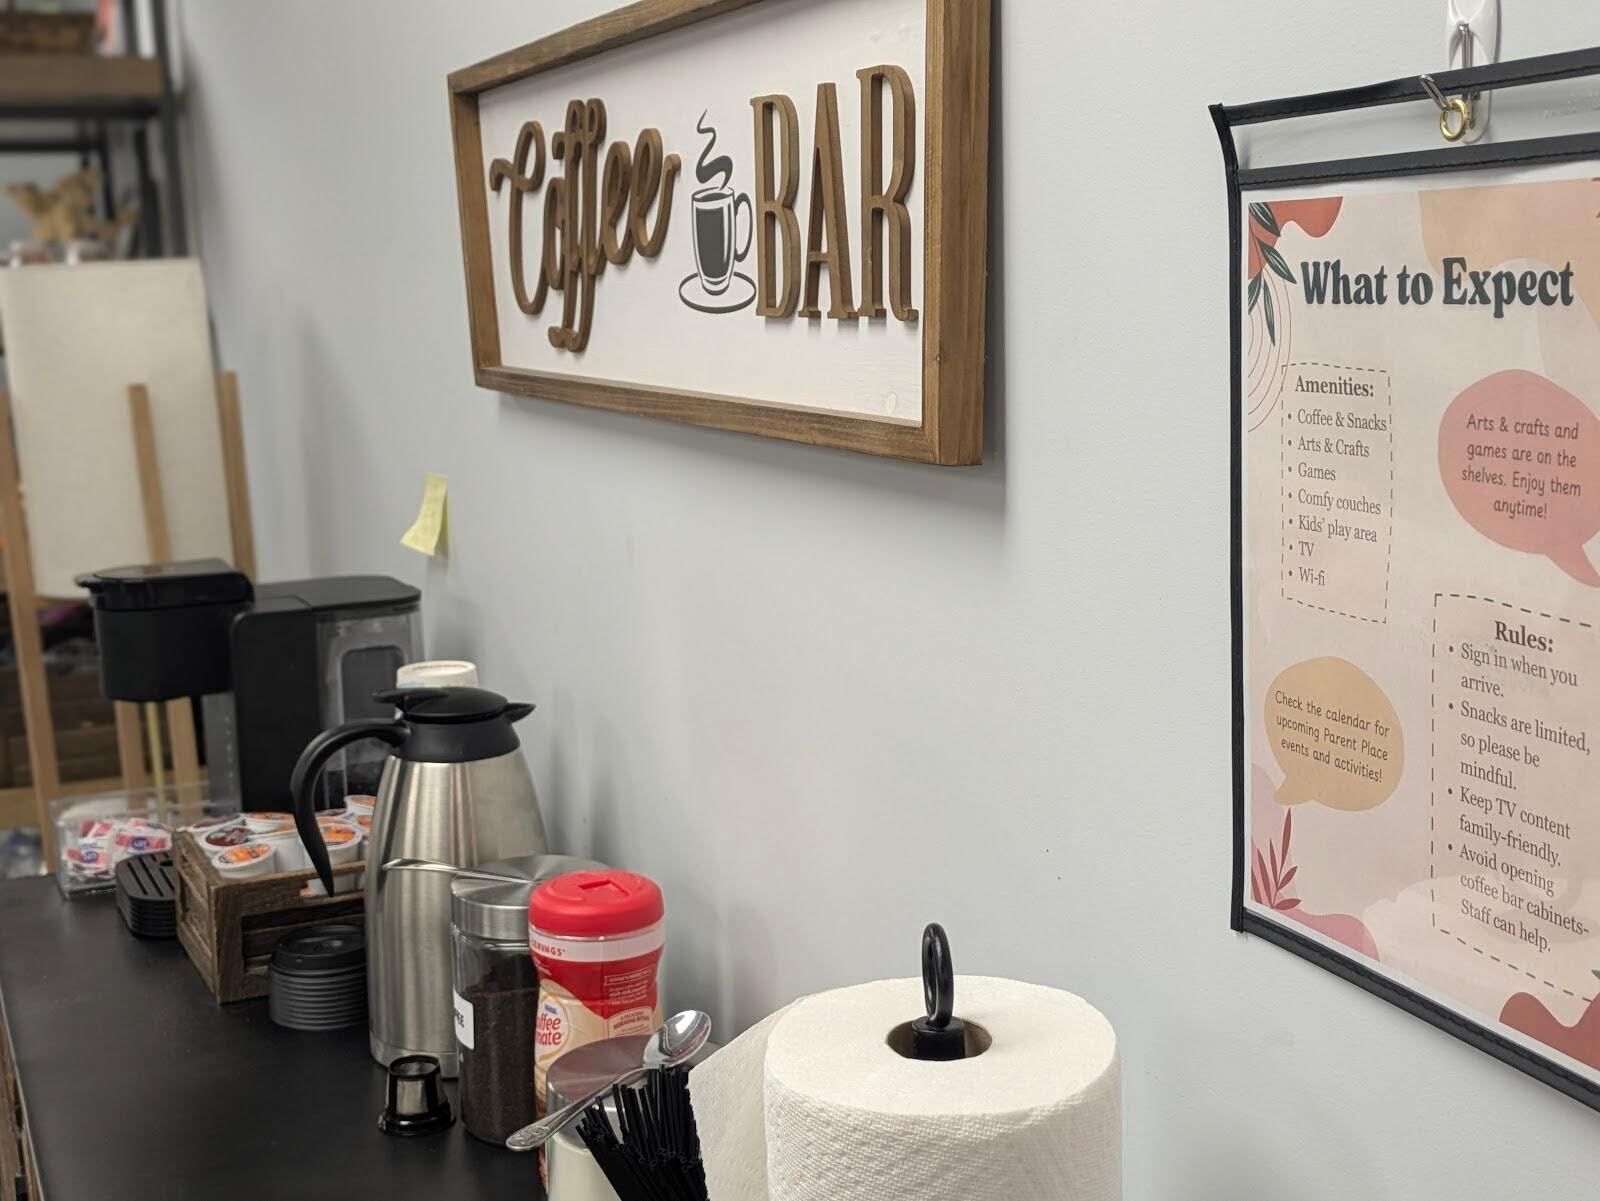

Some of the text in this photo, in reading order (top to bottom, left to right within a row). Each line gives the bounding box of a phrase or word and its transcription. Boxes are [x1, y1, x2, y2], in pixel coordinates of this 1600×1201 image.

[489, 64, 919, 352] Coffee BAR
[1300, 257, 1574, 318] What to Expect
[1295, 375, 1374, 397] Amenities:
[1297, 408, 1387, 431] Coffee & Snacks
[1466, 413, 1579, 440] Arts & crafts and
[1297, 435, 1370, 457] Arts & Crafts
[1467, 443, 1577, 468] games are on the
[1298, 462, 1336, 481] Games
[1462, 465, 1581, 497] shelves. Enjoy them
[1298, 488, 1382, 515] Comfy couches
[1493, 498, 1547, 520] anytime!
[1328, 520, 1352, 540] play
[1353, 527, 1378, 543] area
[1298, 541, 1315, 558] TV
[1298, 567, 1326, 587] Wi-fi
[1495, 620, 1553, 652] Rules:
[1461, 642, 1578, 687] Sign in when you
[1461, 675, 1505, 698] arrive.
[1275, 690, 1390, 737] Check the calendar for
[1461, 700, 1591, 755] Snacks are limited,
[1276, 715, 1388, 761] upcoming Parent Place
[1460, 732, 1540, 768] so please be
[1281, 738, 1383, 783] events and activities!
[1460, 760, 1517, 790] mindful.
[1460, 786, 1571, 840] Keep TV content
[1459, 814, 1561, 868] family-friendly.
[1459, 843, 1554, 898] Avoid opening
[1460, 874, 1590, 936] coffee bar cabinets-
[1461, 898, 1552, 953] Staff can help.
